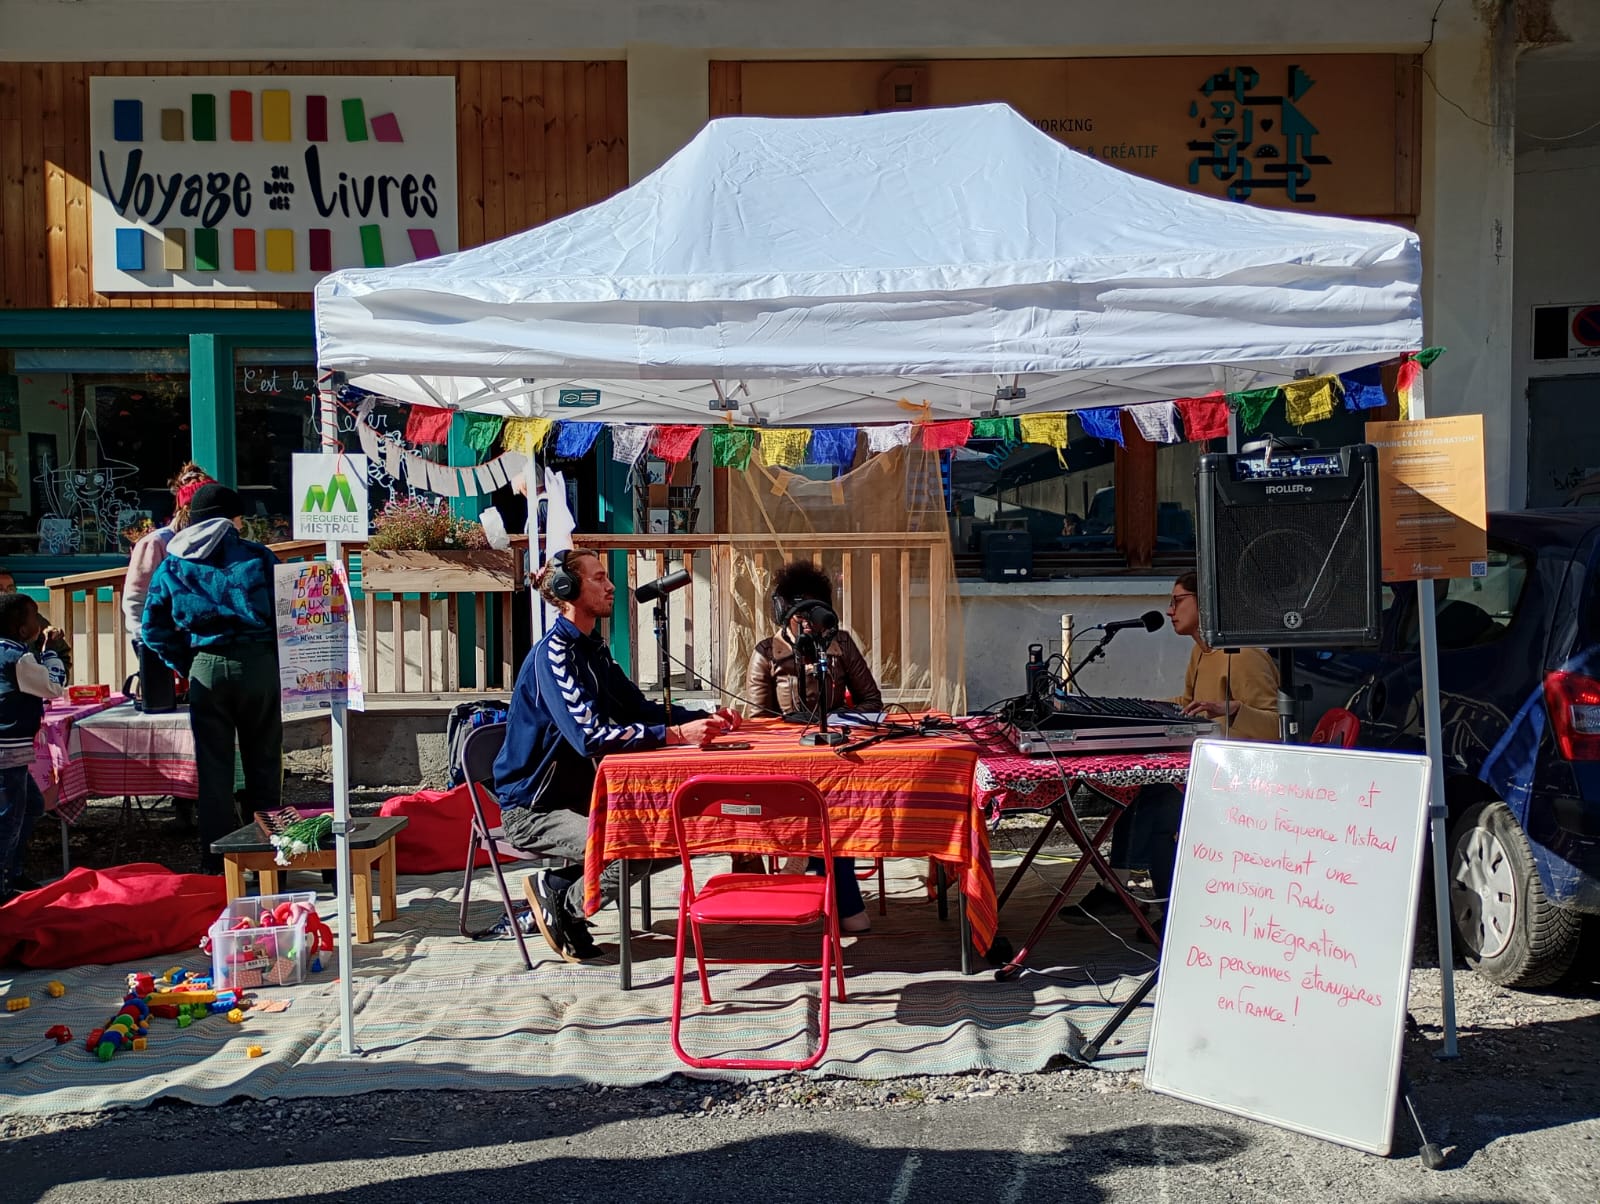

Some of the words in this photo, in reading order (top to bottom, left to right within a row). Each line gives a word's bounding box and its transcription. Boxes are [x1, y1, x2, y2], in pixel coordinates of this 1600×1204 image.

[1103, 142, 1159, 159] CRÉATIF
[99, 148, 252, 228] Voyage
[304, 144, 439, 218] Livres
[243, 367, 282, 393] C'est
[292, 370, 310, 391] la
[301, 523, 359, 534] MISTRAL
[299, 599, 325, 611] AUX
[1358, 781, 1382, 808] et
[1326, 869, 1358, 885] une
[1186, 946, 1213, 967] Des
